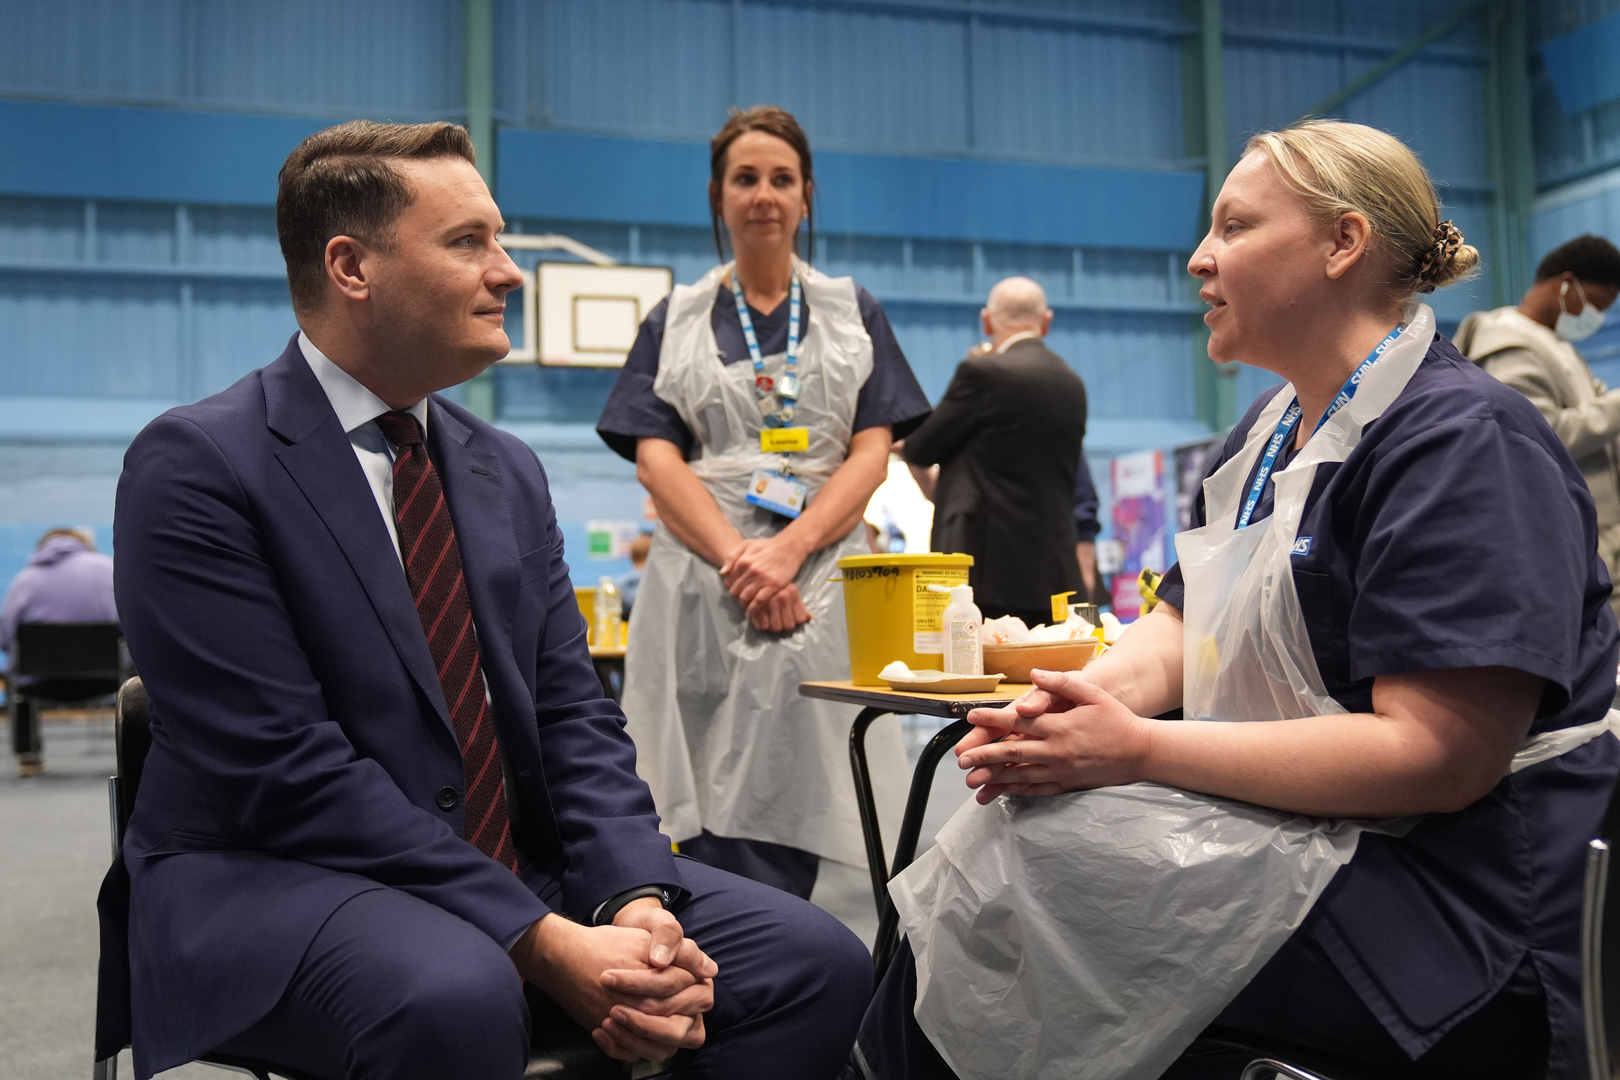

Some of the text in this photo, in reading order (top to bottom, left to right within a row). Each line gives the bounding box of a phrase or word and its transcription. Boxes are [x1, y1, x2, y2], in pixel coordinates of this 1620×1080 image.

[1350, 359, 1373, 385] NHS
[1281, 403, 1301, 427] NHS
[1327, 391, 1351, 418] NHS
[1266, 432, 1284, 458] NHS
[1253, 466, 1269, 491] NHS
[1239, 500, 1255, 525] NHS
[1293, 538, 1310, 552] HS
